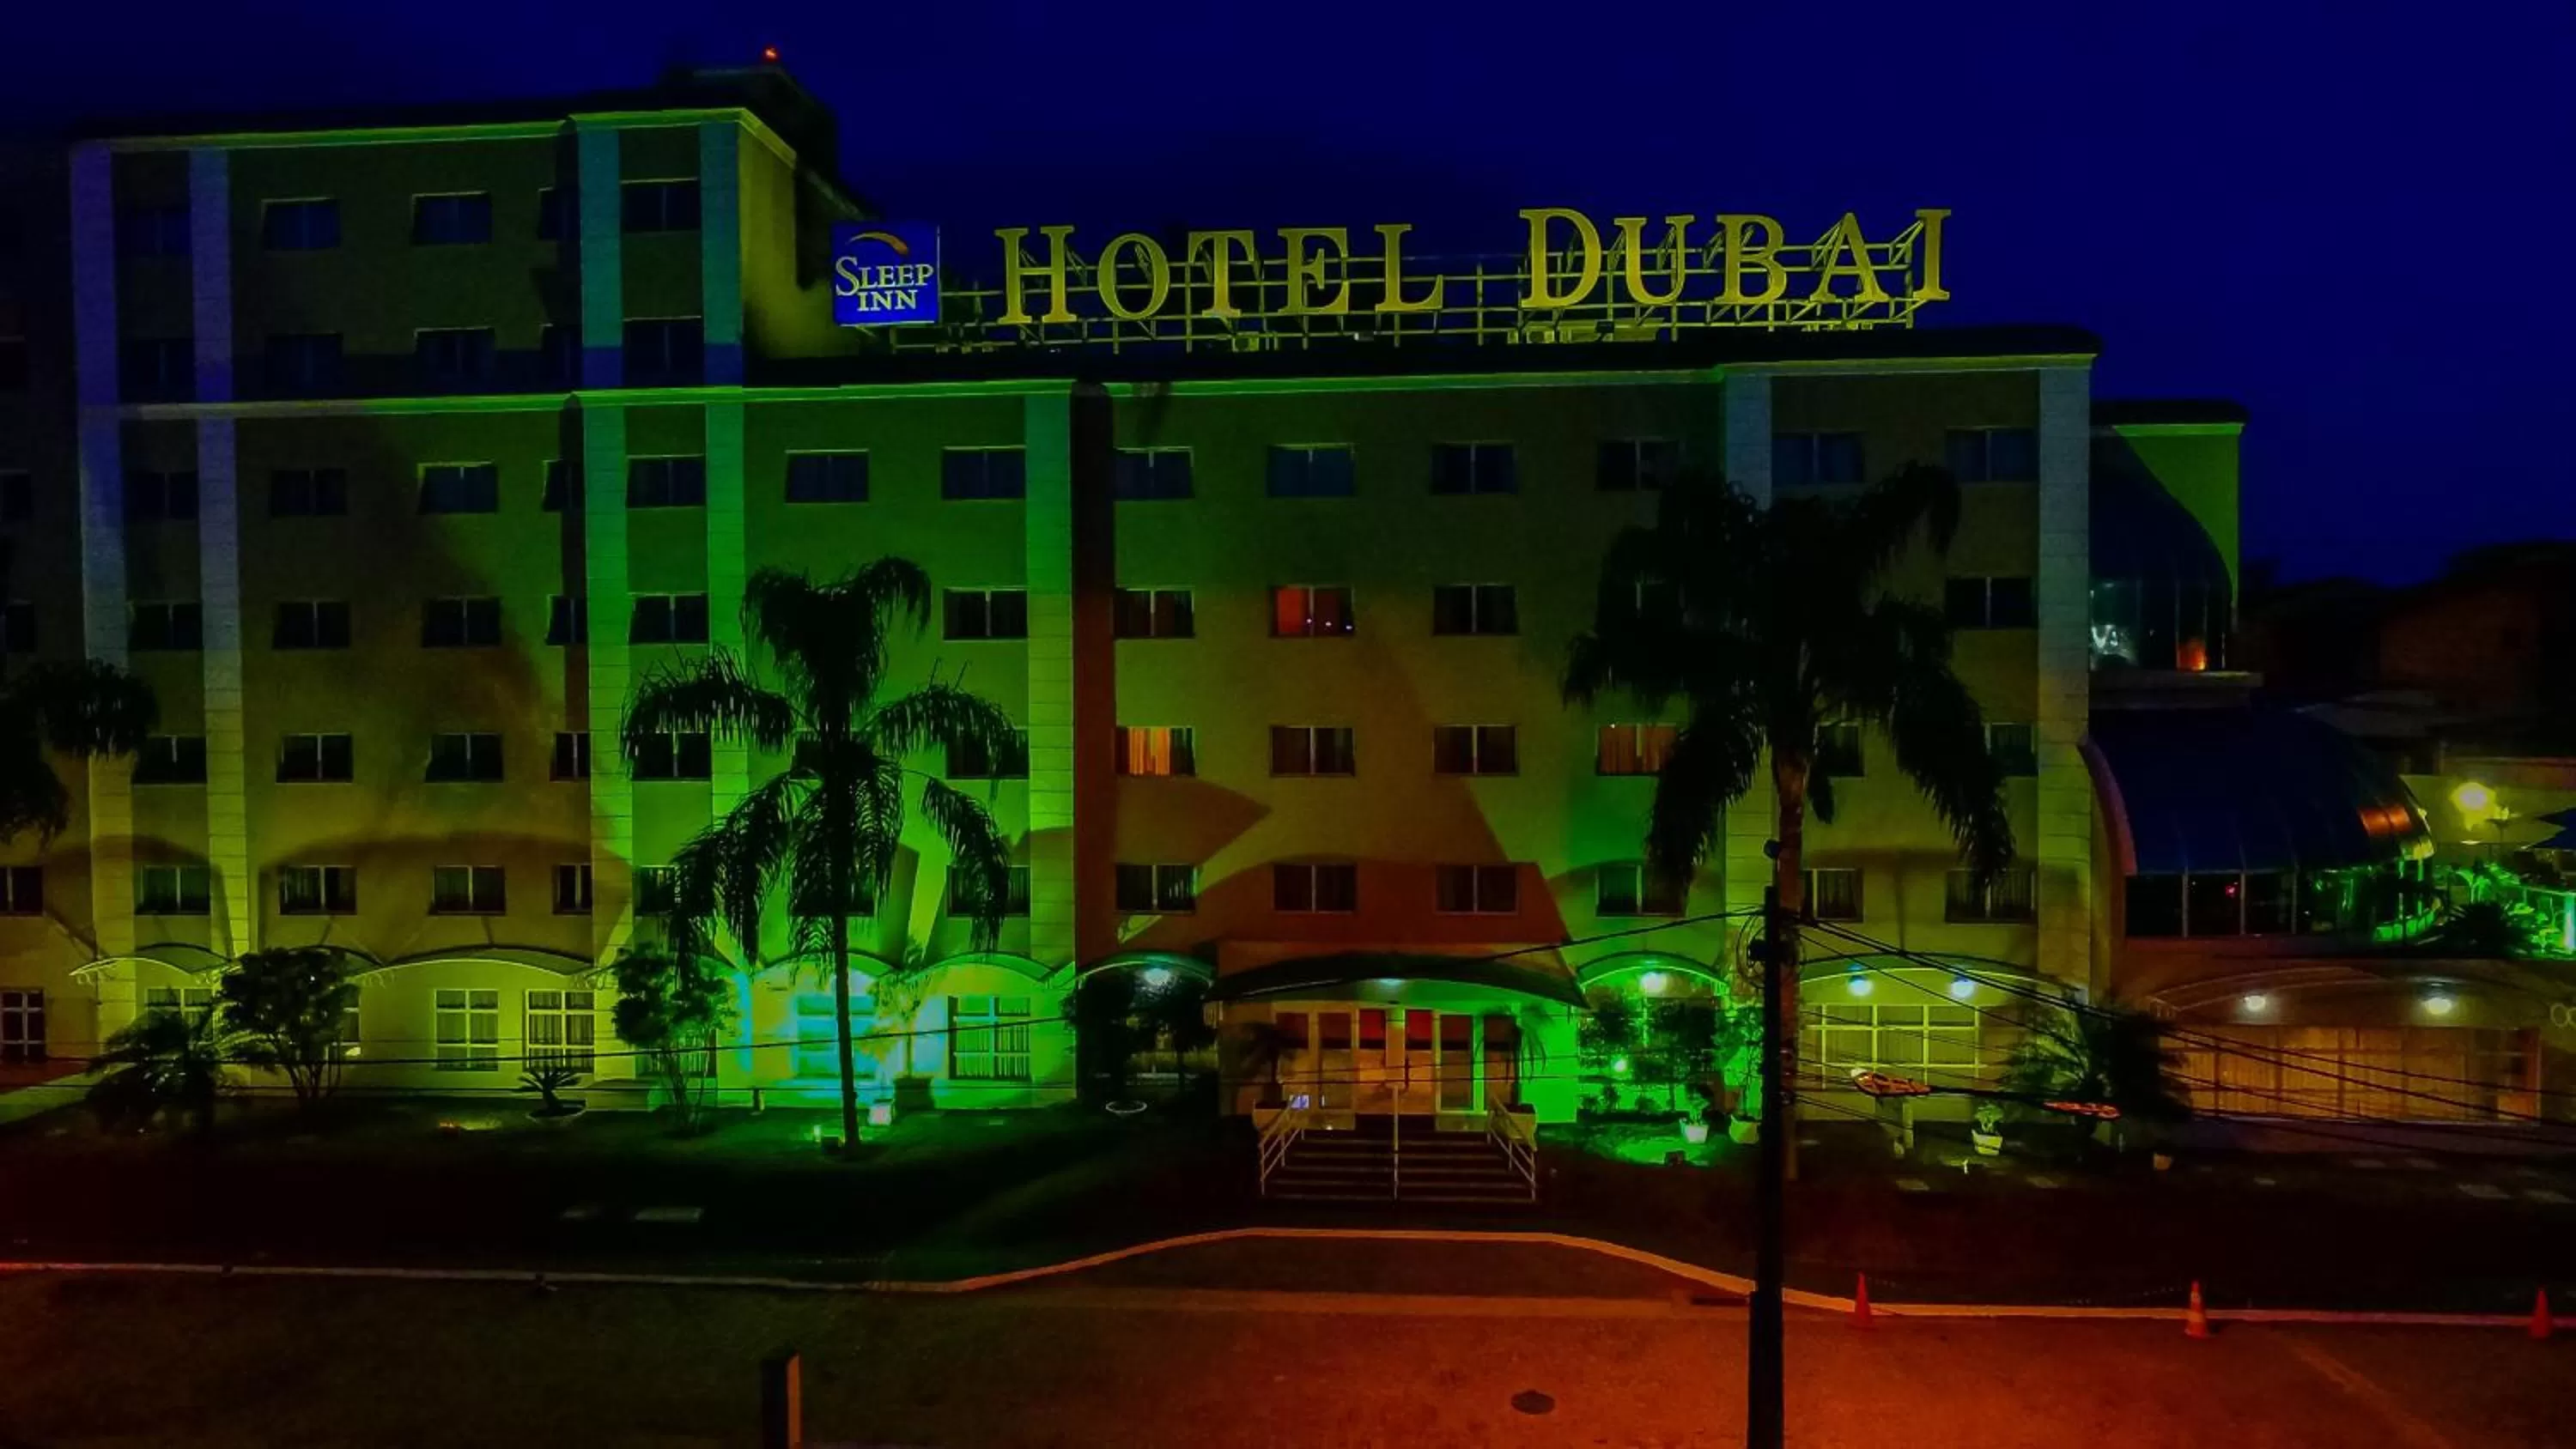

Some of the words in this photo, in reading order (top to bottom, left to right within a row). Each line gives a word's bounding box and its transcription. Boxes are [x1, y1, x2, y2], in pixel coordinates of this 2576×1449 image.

[835, 255, 934, 296] SLEEP
[994, 224, 1444, 324] HOTEL
[1519, 208, 1952, 308] DUBAI
[856, 289, 919, 312] INN
